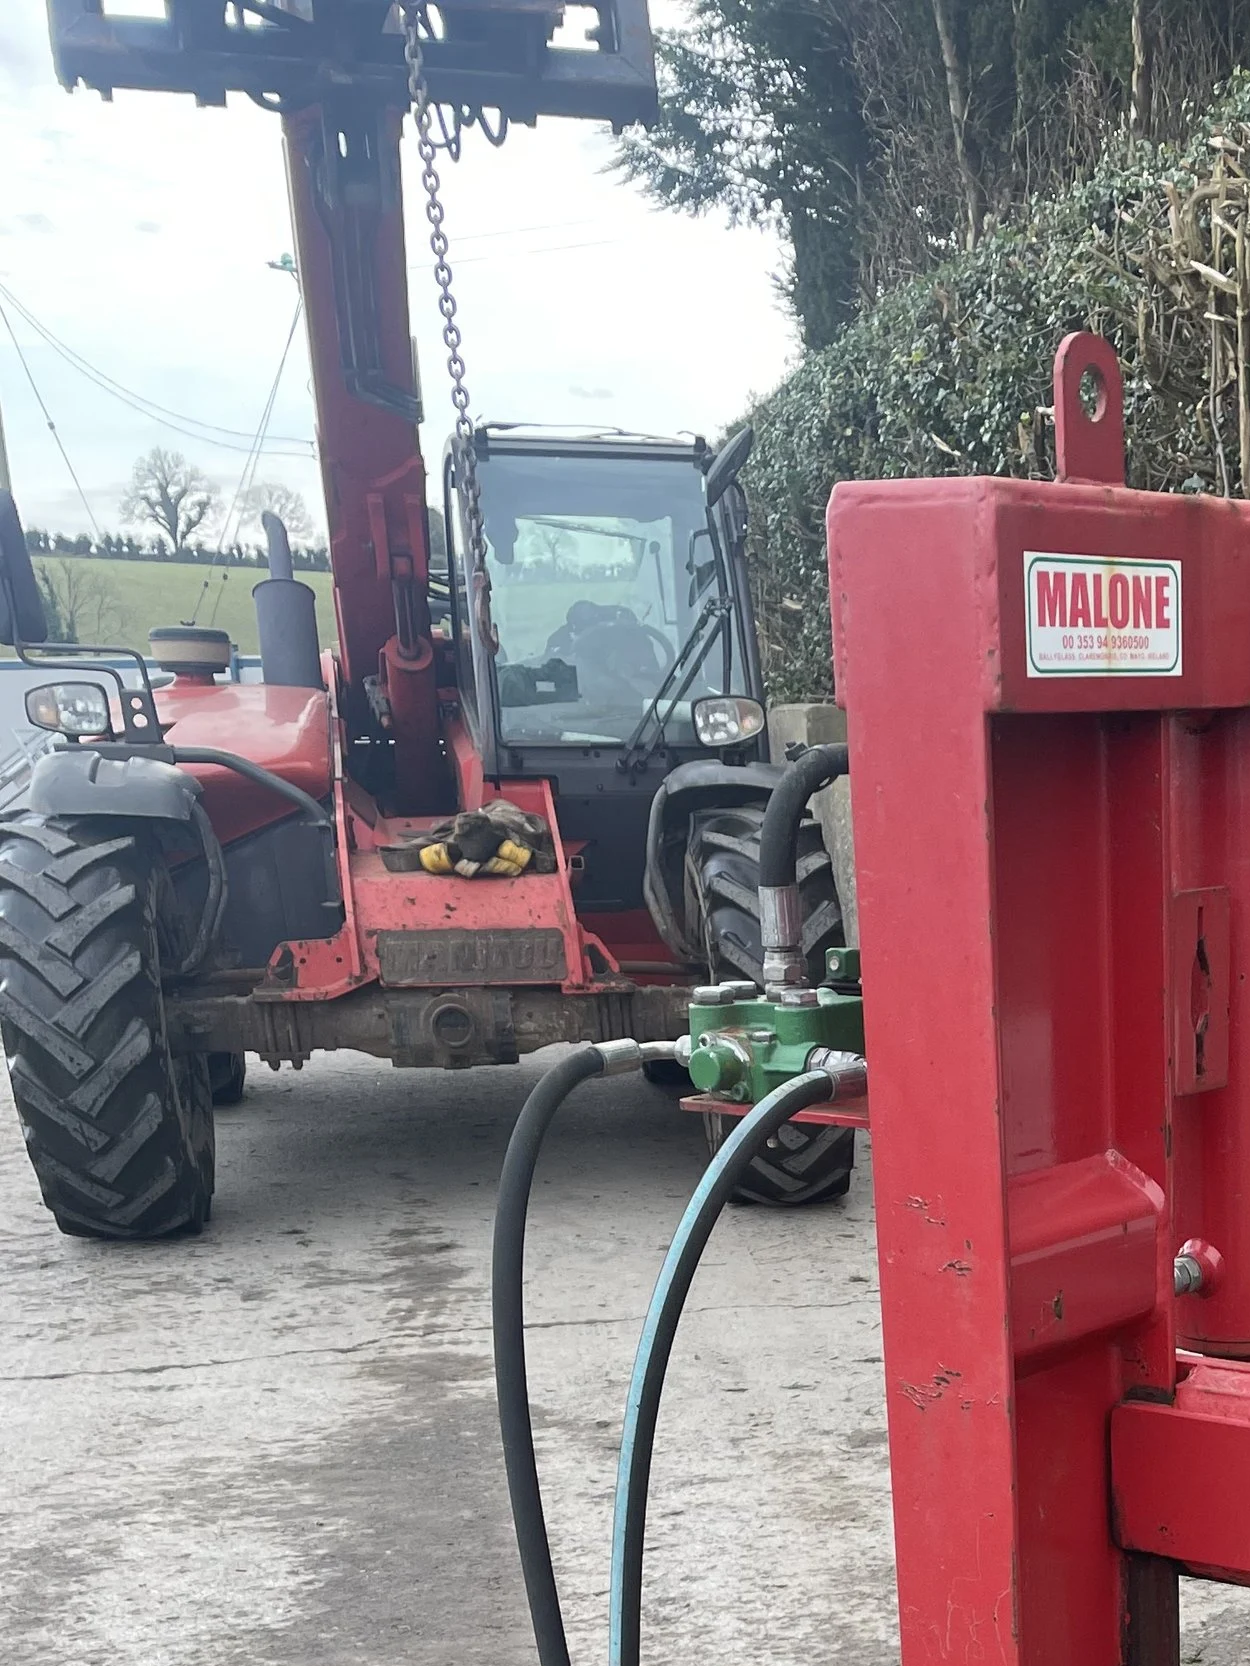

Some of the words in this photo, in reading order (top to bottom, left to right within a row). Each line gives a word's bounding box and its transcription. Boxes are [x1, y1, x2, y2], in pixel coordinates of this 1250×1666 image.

[1036, 570, 1171, 630] MALONE
[1062, 634, 1075, 650] 00
[1077, 634, 1095, 650] 353
[1096, 635, 1109, 650] 94
[1111, 635, 1150, 650] 9360500
